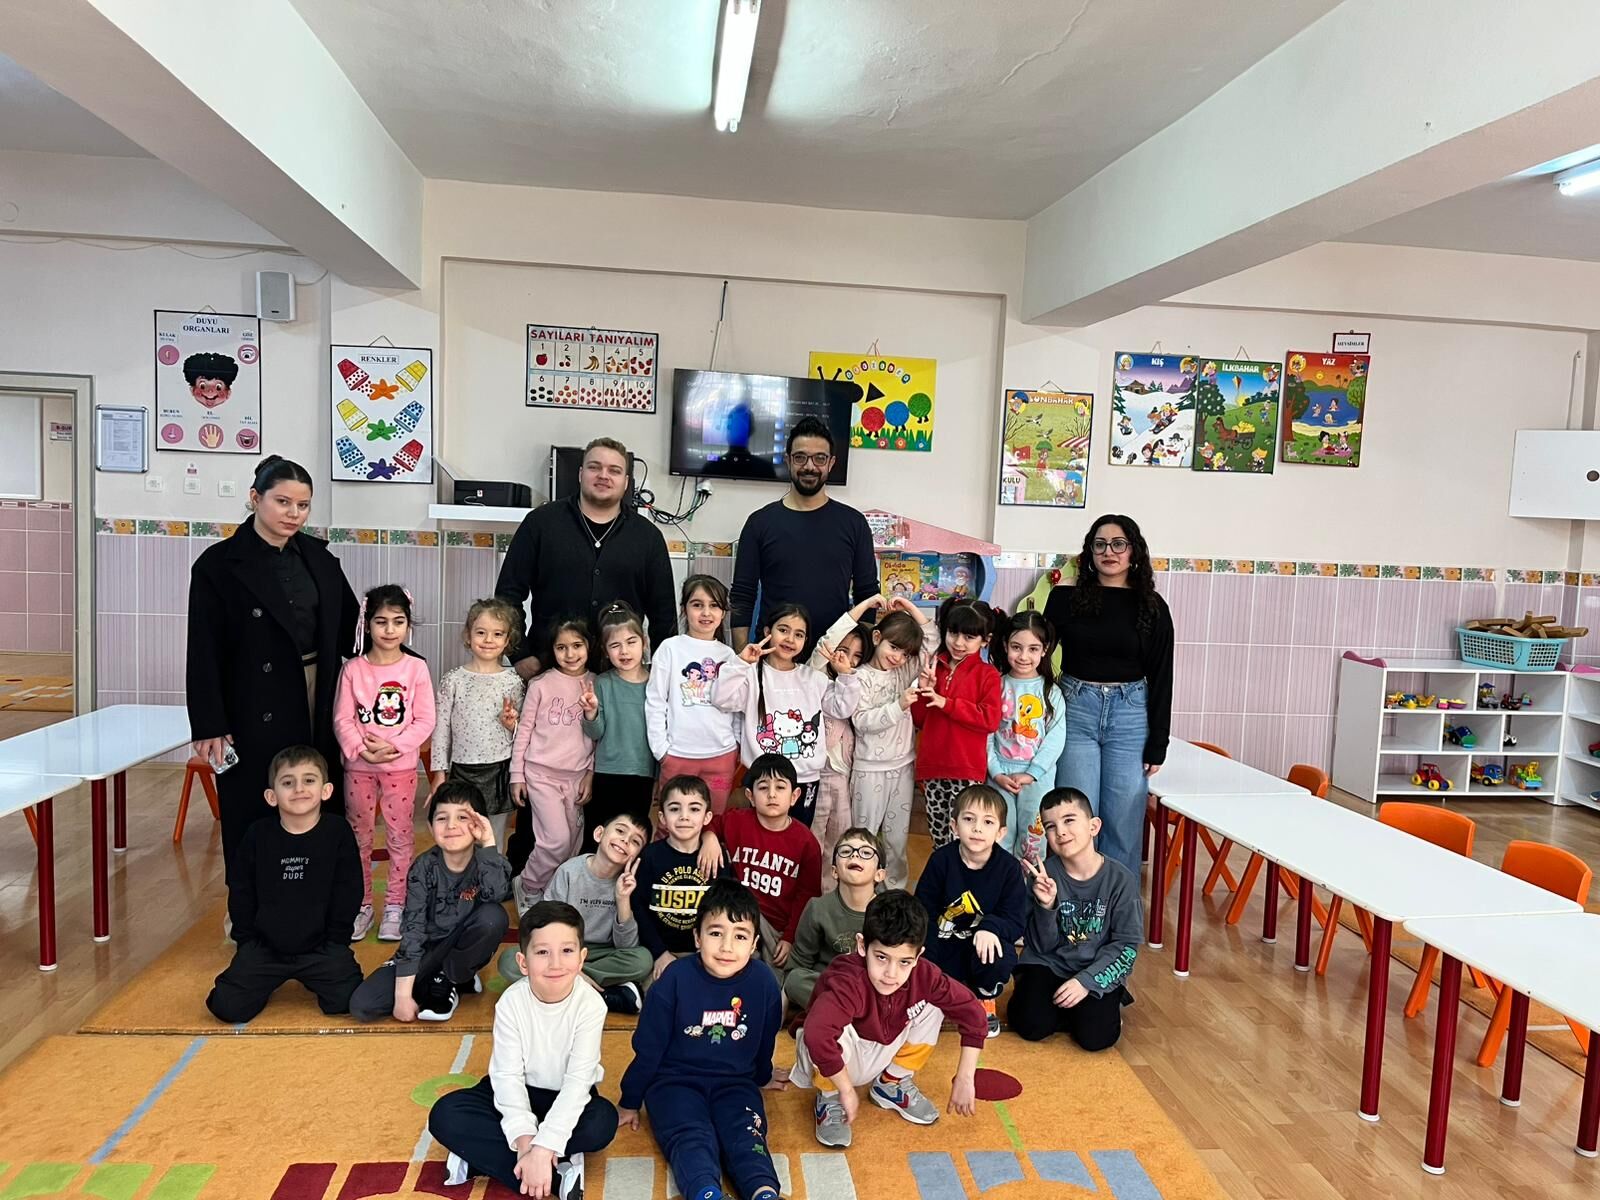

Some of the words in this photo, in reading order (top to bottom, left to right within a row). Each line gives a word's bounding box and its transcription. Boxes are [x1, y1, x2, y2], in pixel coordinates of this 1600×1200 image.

[196, 317, 218, 325] DUYU
[183, 325, 230, 334] ORGANLARI
[530, 329, 584, 342] SAYILARI
[589, 334, 654, 346] TANIYALIM
[1151, 357, 1164, 367] KIŞ
[1321, 358, 1336, 366] YAZ
[1222, 362, 1260, 373] İLKBAHAR
[636, 381, 645, 389] 10
[726, 846, 800, 878] ATLANTA
[283, 872, 304, 880] DUDE
[661, 871, 674, 884] U.S.
[673, 866, 692, 875] POLO
[741, 867, 782, 897] 1999
[702, 1010, 737, 1028] MARVEL
